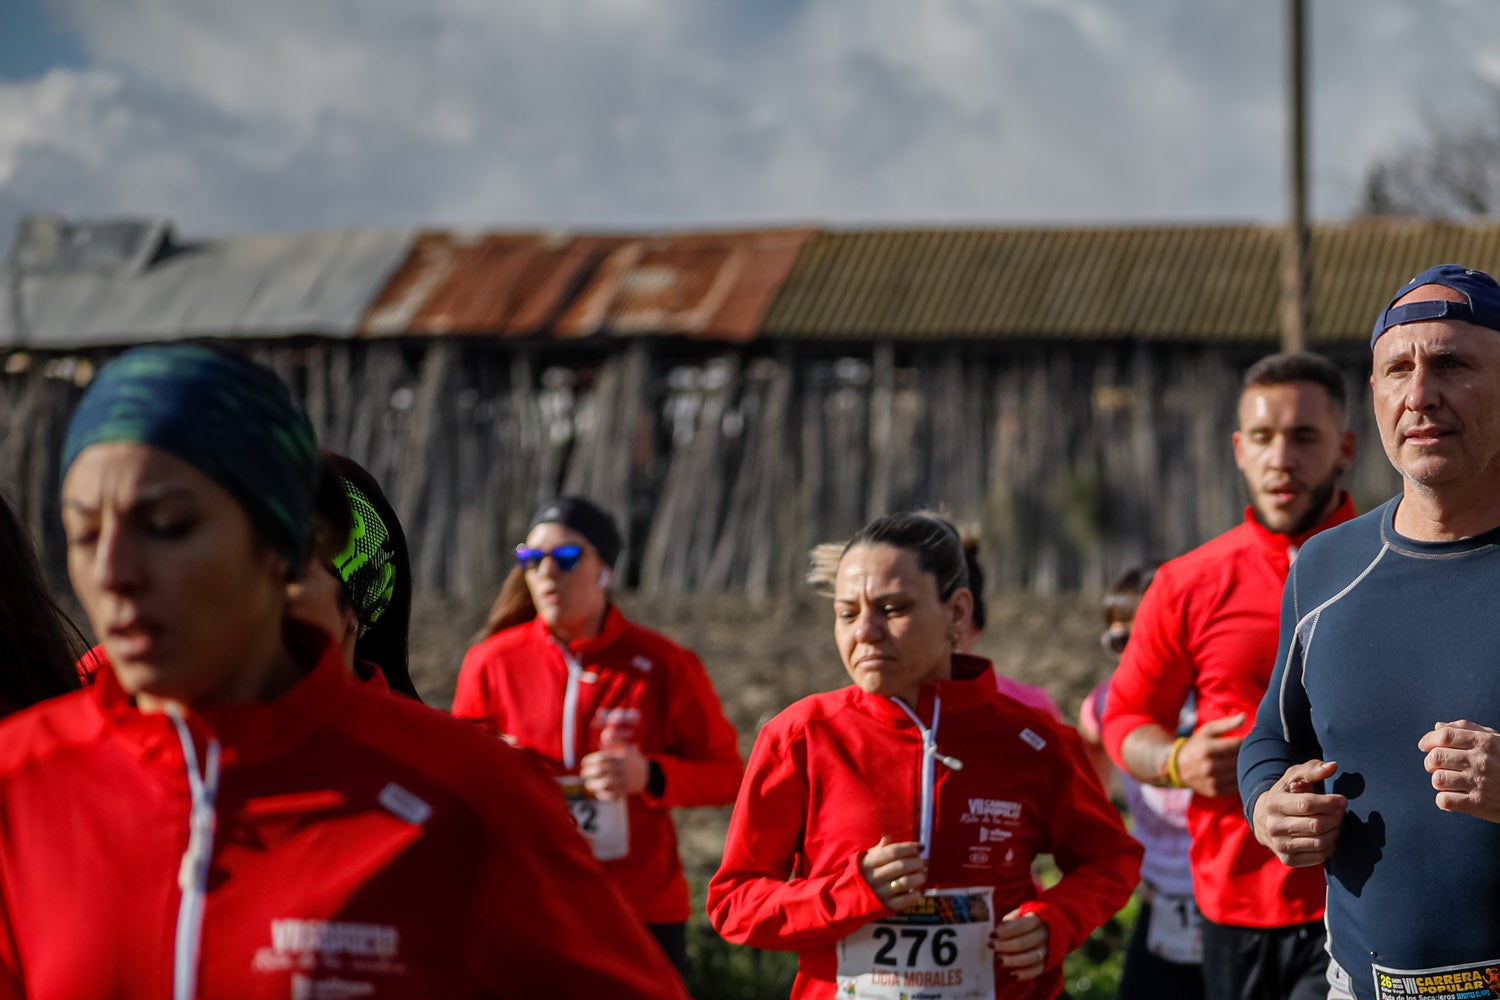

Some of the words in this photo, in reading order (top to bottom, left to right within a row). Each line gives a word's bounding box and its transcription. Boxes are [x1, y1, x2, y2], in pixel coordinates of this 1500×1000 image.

[872, 926, 957, 967] 276
[904, 967, 962, 987] MORALES
[1380, 974, 1392, 988] 26
[1416, 970, 1482, 986] CARRERA
[1418, 980, 1484, 994] POPULAR
